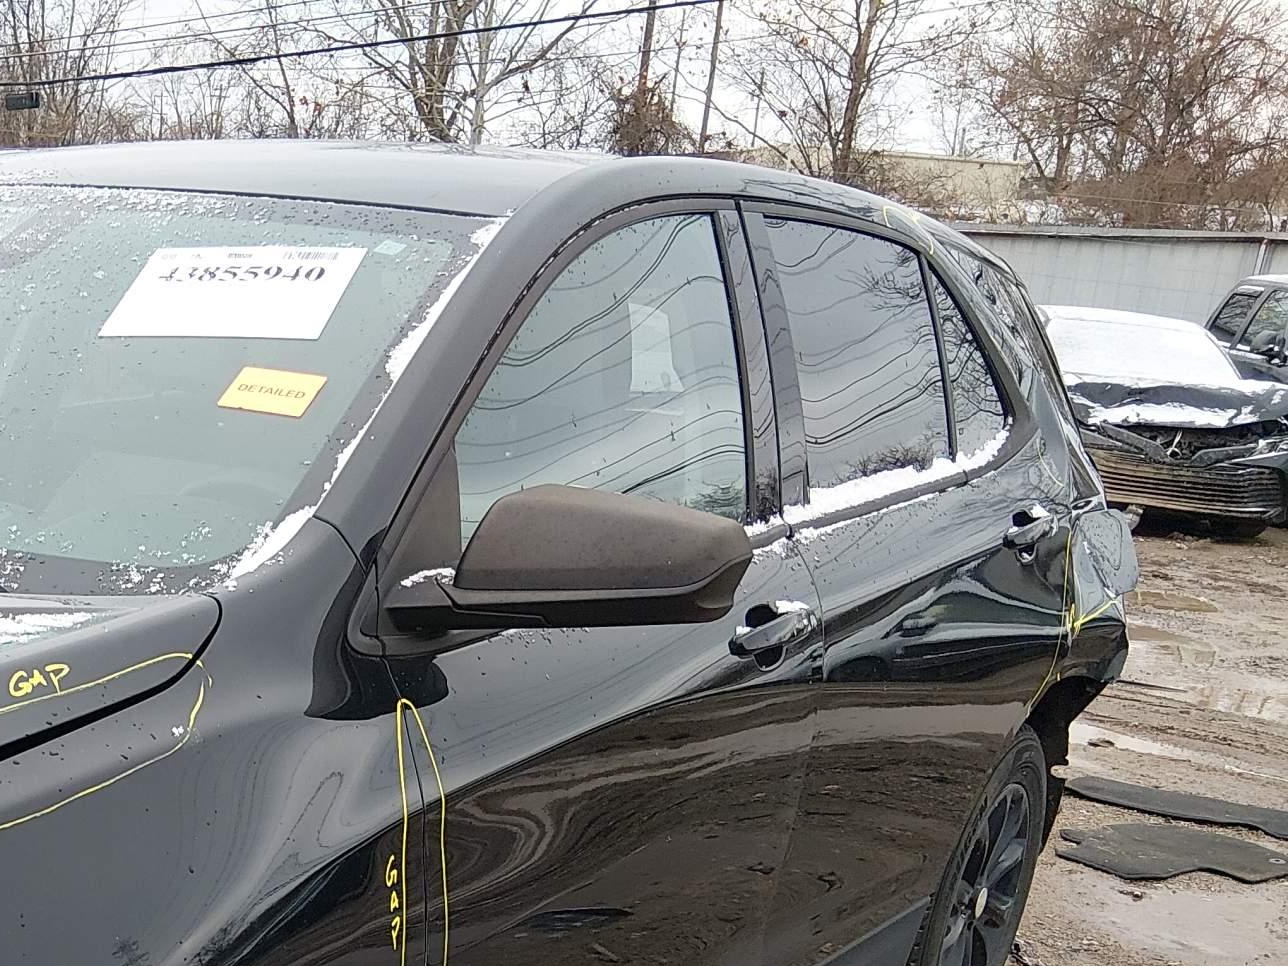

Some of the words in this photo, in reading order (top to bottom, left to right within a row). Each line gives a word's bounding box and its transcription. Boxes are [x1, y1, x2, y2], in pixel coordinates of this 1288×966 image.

[158, 265, 327, 281] 43855940
[237, 383, 306, 399] DETAILED
[8, 663, 71, 697] GAP
[385, 854, 401, 951] GAP
